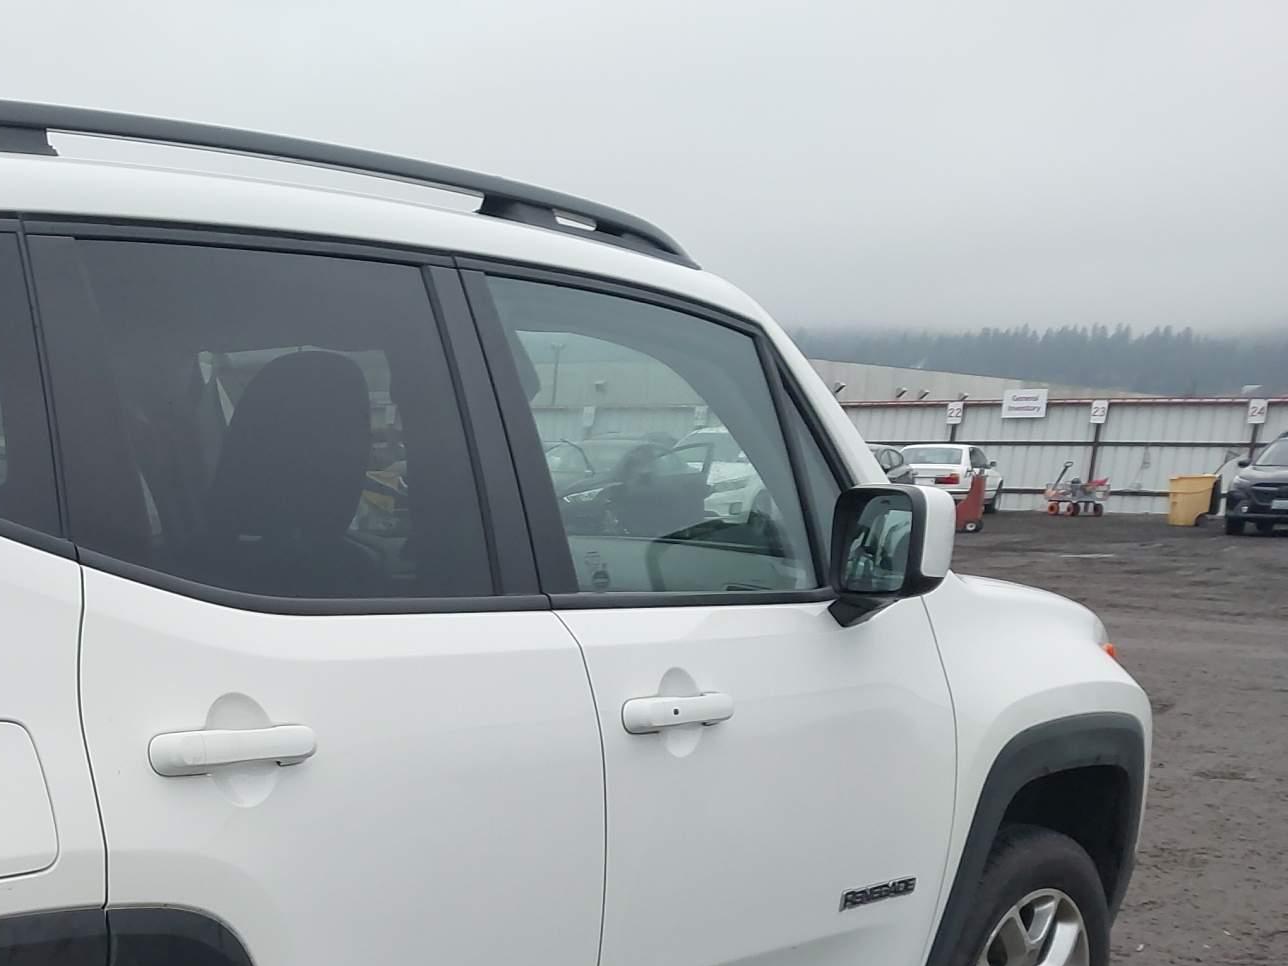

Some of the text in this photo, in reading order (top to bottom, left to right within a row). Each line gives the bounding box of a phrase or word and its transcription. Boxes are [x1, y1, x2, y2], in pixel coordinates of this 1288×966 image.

[948, 407, 961, 418] 22
[1092, 406, 1105, 417] 23
[1251, 406, 1265, 417] 24
[839, 876, 917, 912] RENEGADE
